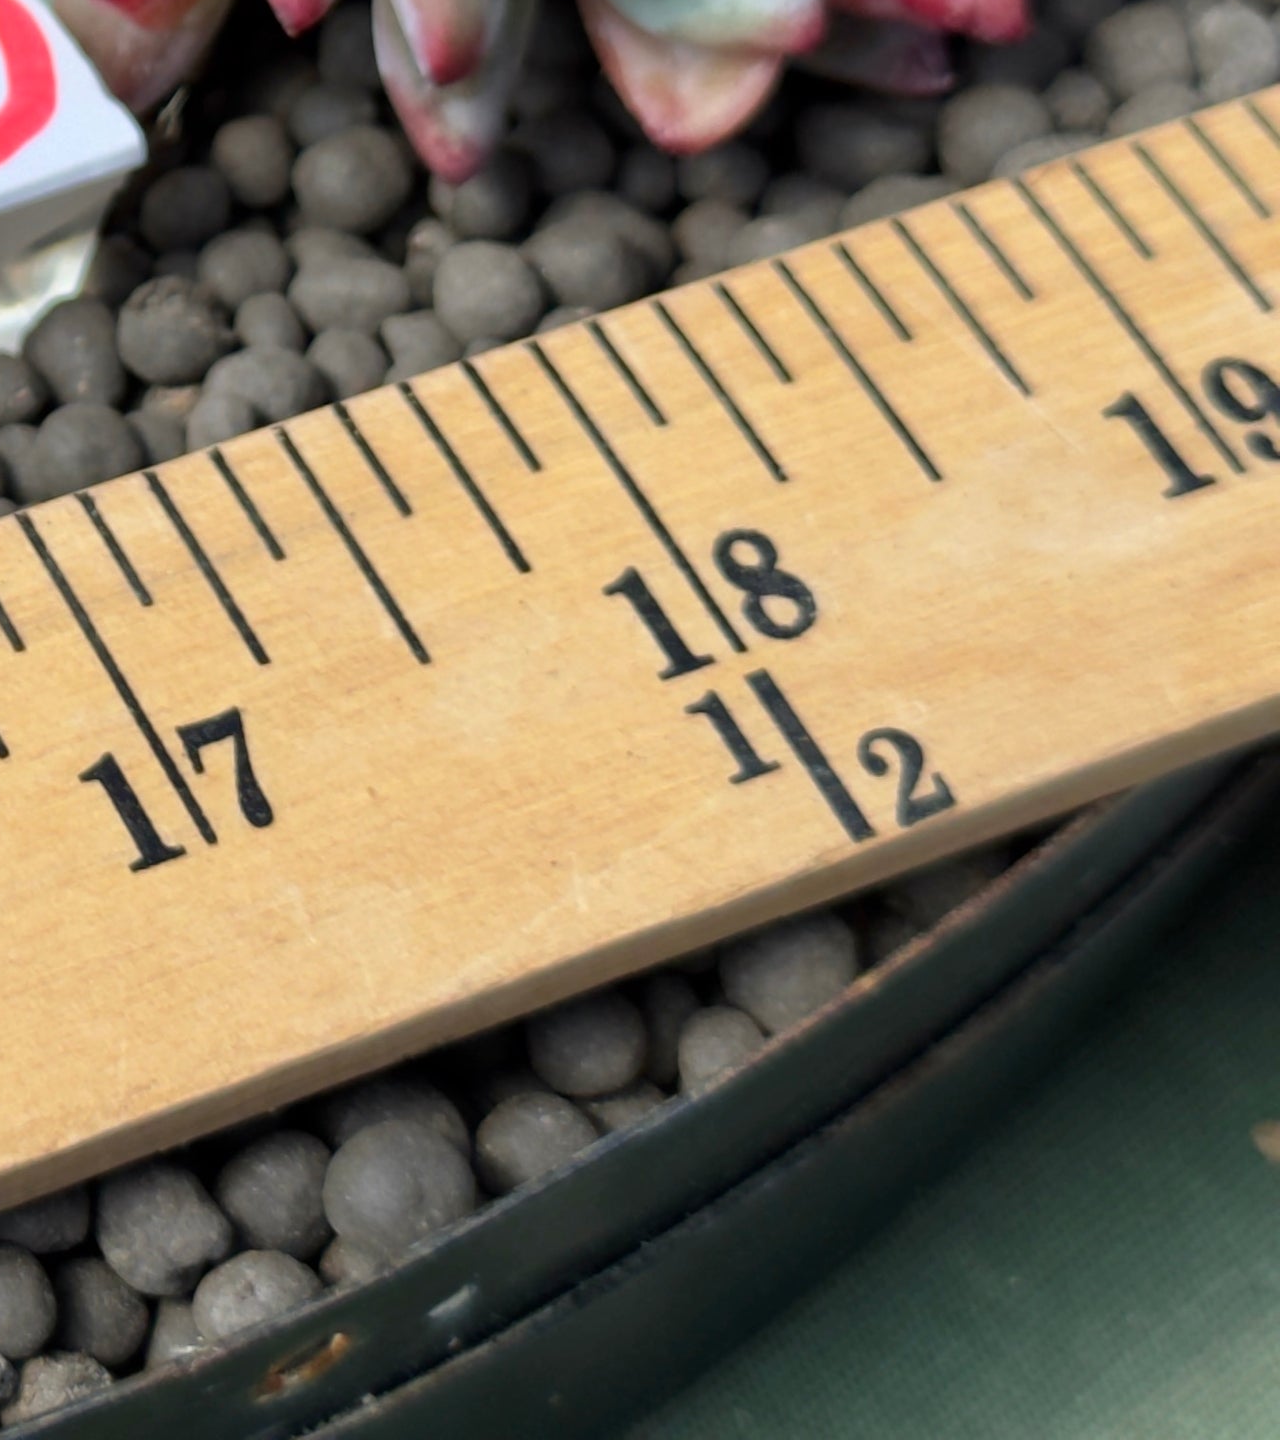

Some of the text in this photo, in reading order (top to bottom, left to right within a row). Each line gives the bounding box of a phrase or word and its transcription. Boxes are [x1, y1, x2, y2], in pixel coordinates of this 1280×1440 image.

[1101, 356, 1280, 499] 19
[602, 527, 819, 682] 18
[77, 705, 276, 875] 17
